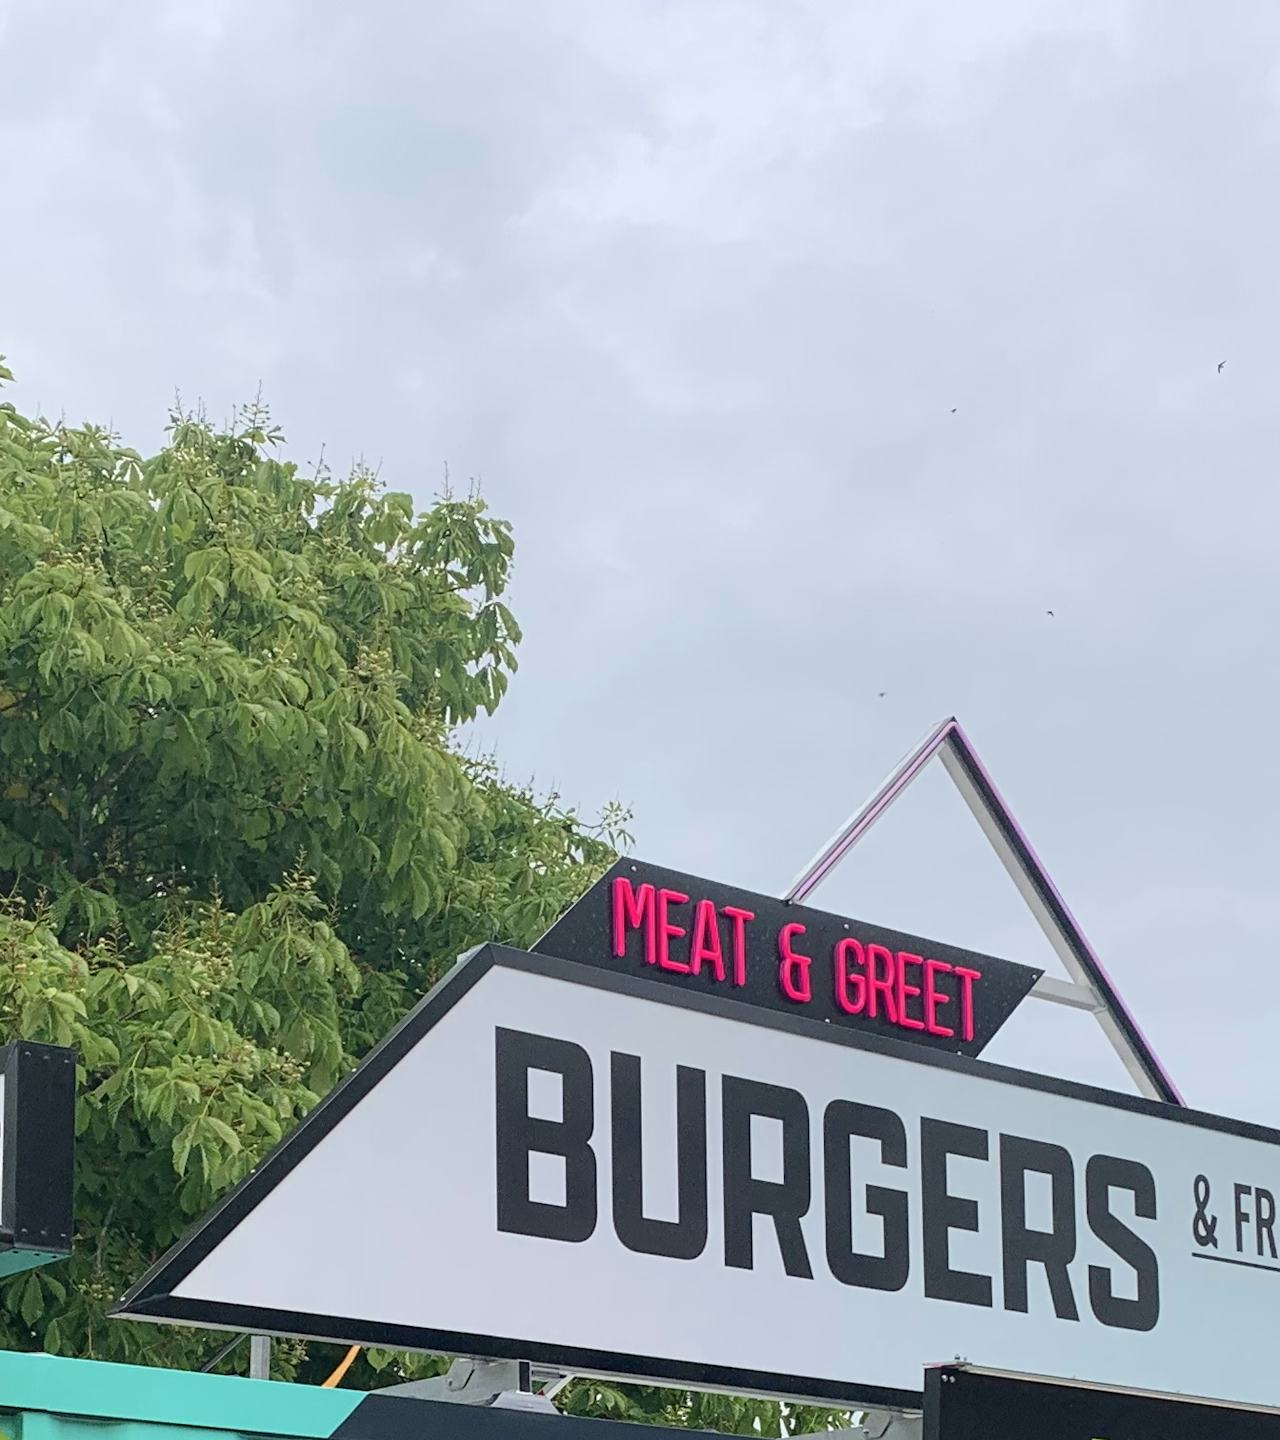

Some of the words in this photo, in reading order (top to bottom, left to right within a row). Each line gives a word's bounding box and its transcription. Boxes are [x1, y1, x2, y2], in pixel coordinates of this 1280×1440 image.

[612, 876, 756, 987] MEAT
[778, 922, 812, 1003] &
[833, 936, 982, 1042] GREET
[494, 1025, 1159, 1333] BURGERS
[1192, 1174, 1218, 1250] &
